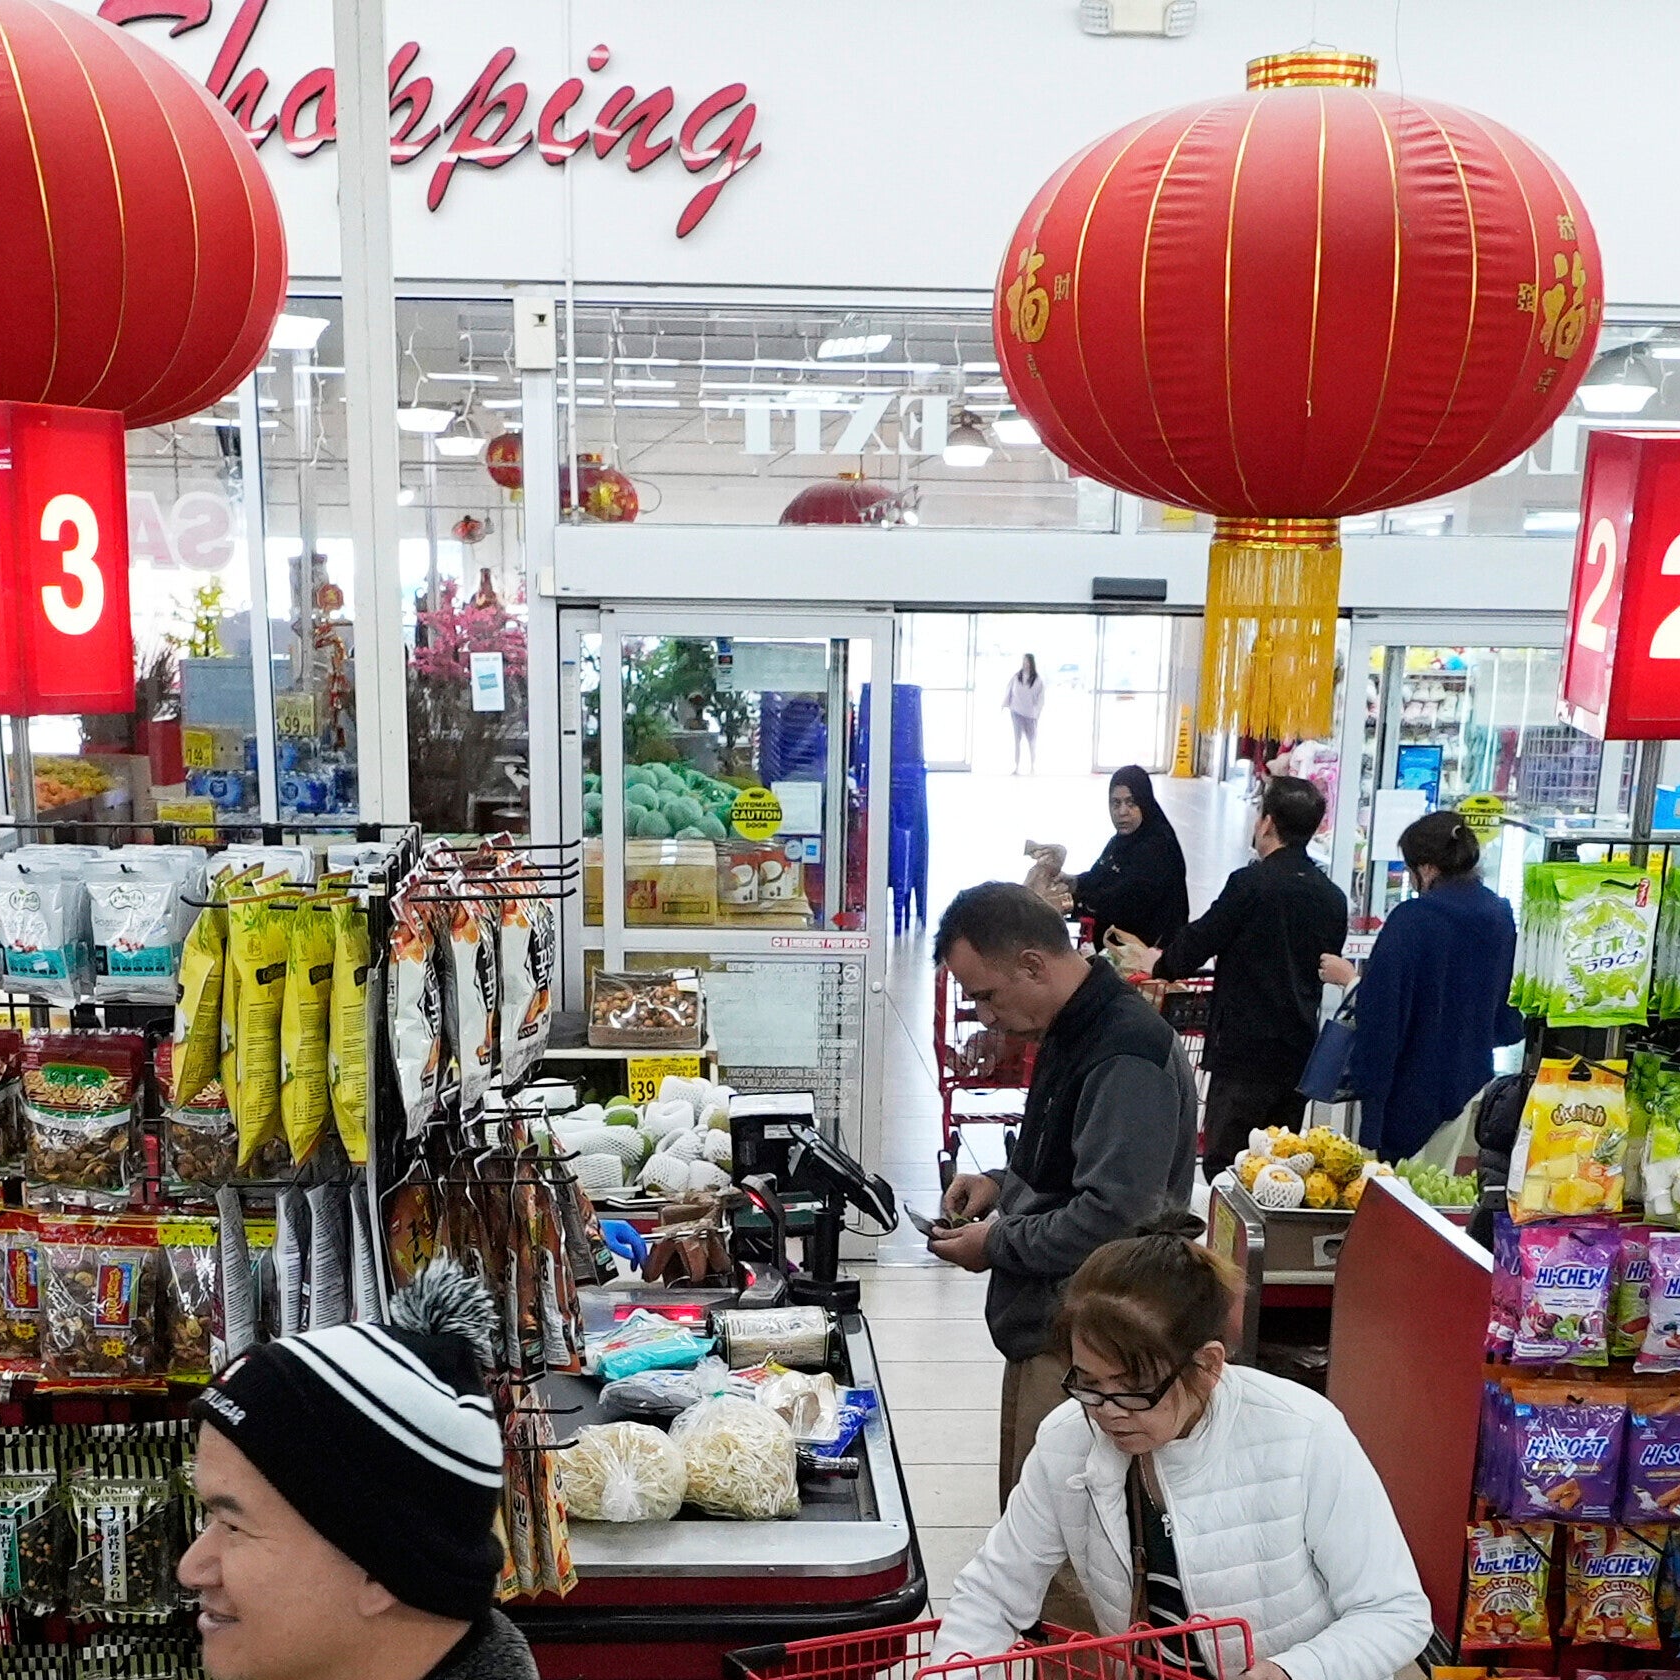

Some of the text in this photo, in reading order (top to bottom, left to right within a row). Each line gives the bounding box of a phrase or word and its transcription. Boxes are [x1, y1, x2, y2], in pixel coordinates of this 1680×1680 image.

[97, 0, 762, 239] hopping
[1007, 248, 1049, 344] 福
[38, 495, 106, 635] 3
[1579, 517, 1617, 653] 2
[731, 809, 782, 820] CAUTION
[1534, 1266, 1609, 1290] HI-CHEW
[1526, 1435, 1608, 1460] HI-SOFT
[1583, 1556, 1657, 1577] HI-CHEW
[1476, 1577, 1538, 1599] Getaway
[1586, 1579, 1652, 1600] Getaway
